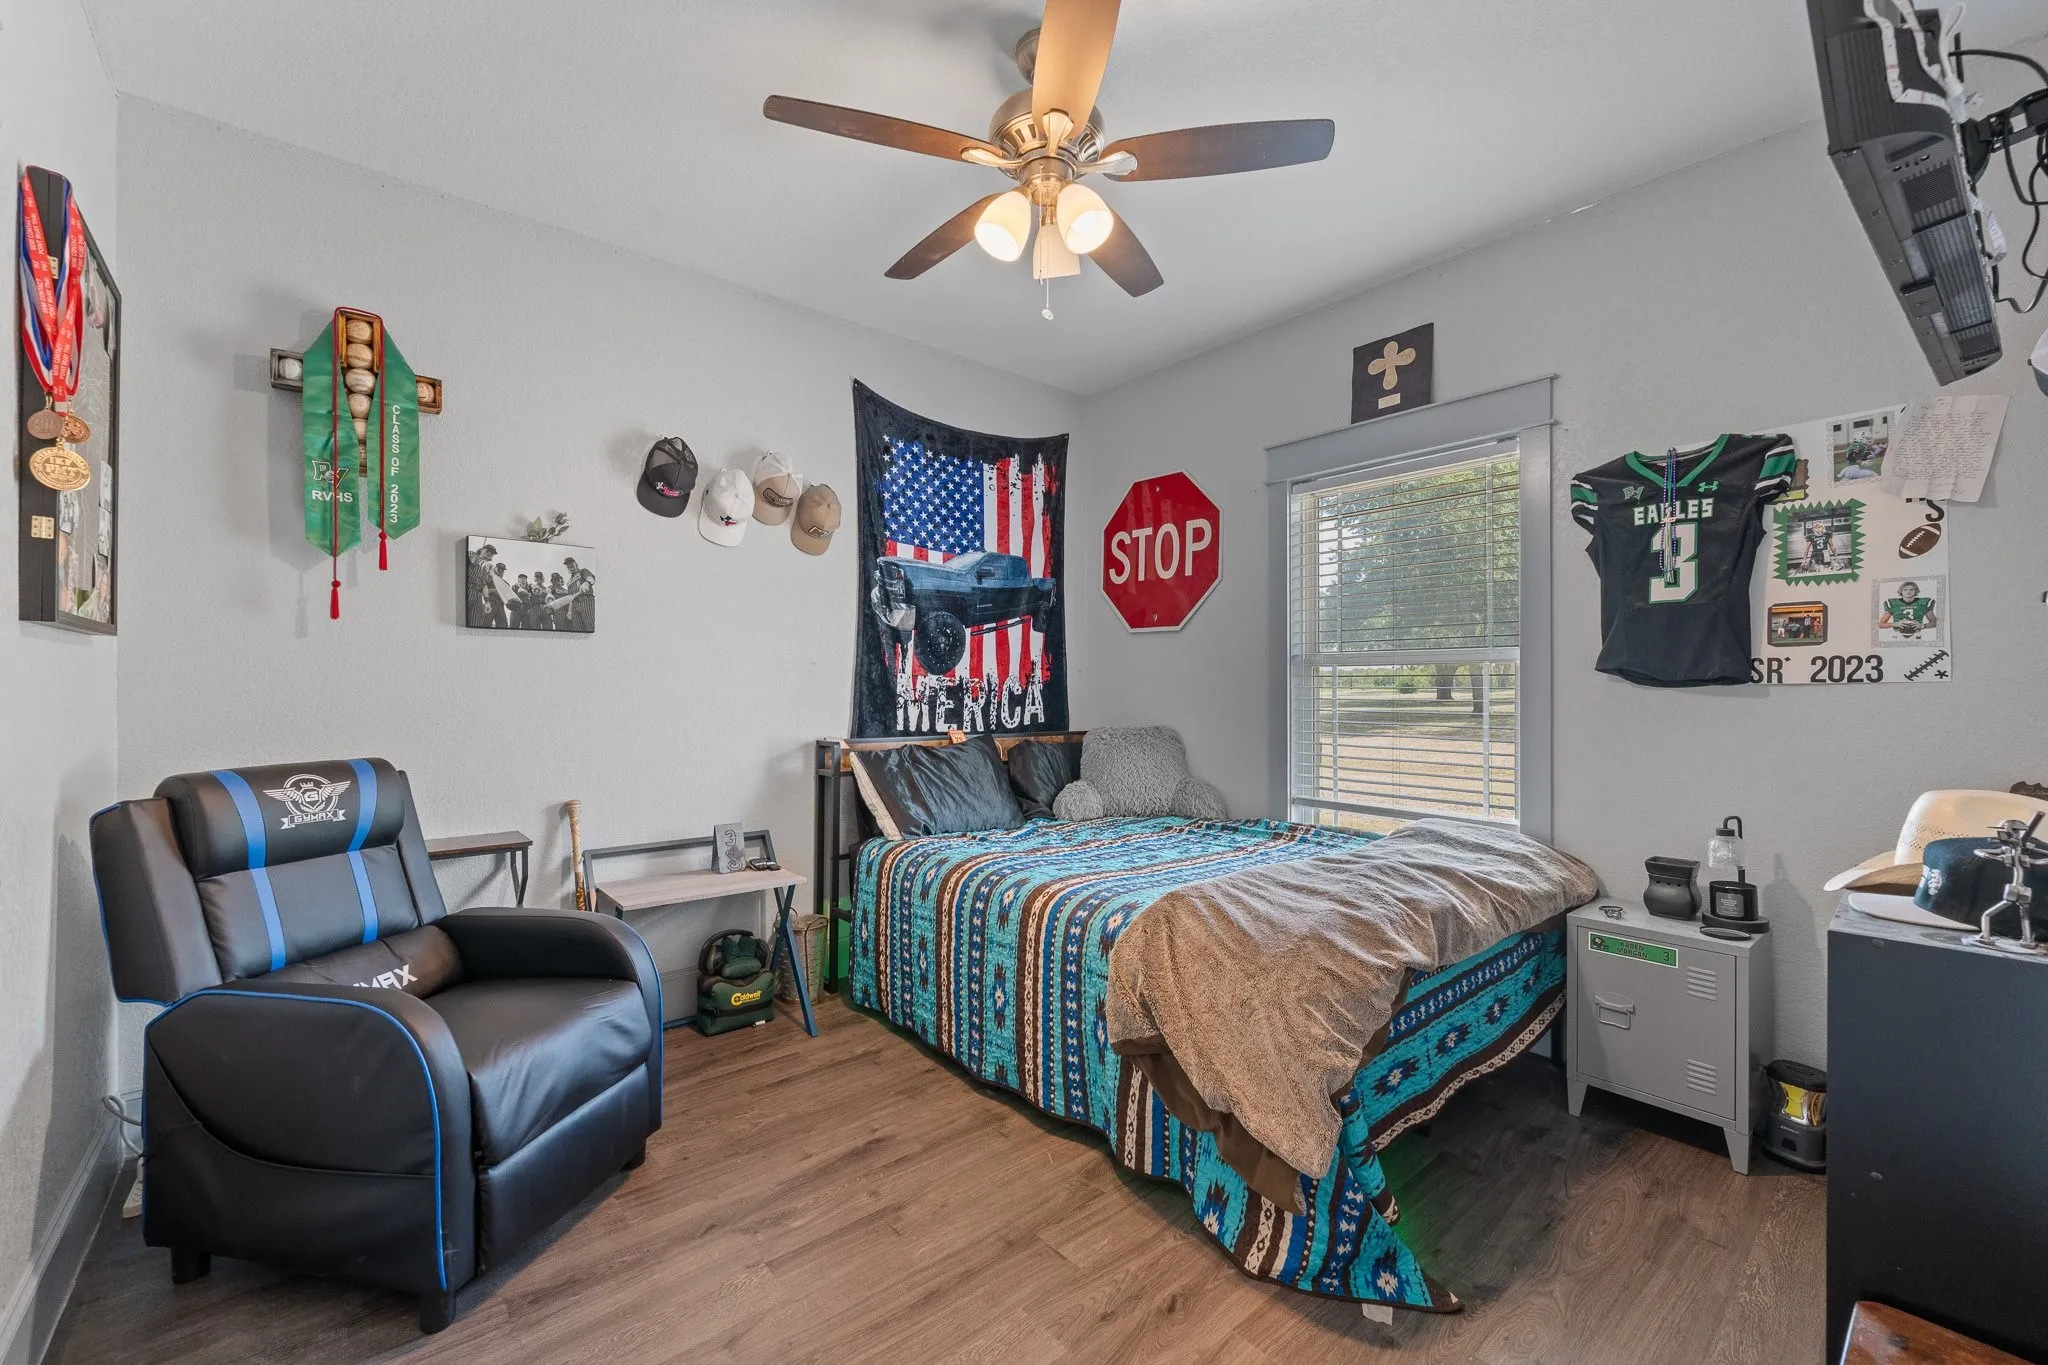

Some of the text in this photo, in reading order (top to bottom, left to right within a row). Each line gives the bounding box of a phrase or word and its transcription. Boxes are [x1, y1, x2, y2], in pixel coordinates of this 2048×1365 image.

[390, 405, 400, 523] CLASS OF 2023
[312, 490, 353, 502] RVHS
[1109, 518, 1212, 585] STOP
[1817, 540, 1824, 549] 3
[1649, 522, 1698, 604] 3
[1810, 655, 1883, 683] 2023
[896, 672, 1045, 732] MERICA
[294, 811, 334, 823] GYMAX
[1616, 947, 1670, 961] MORGAN 3
